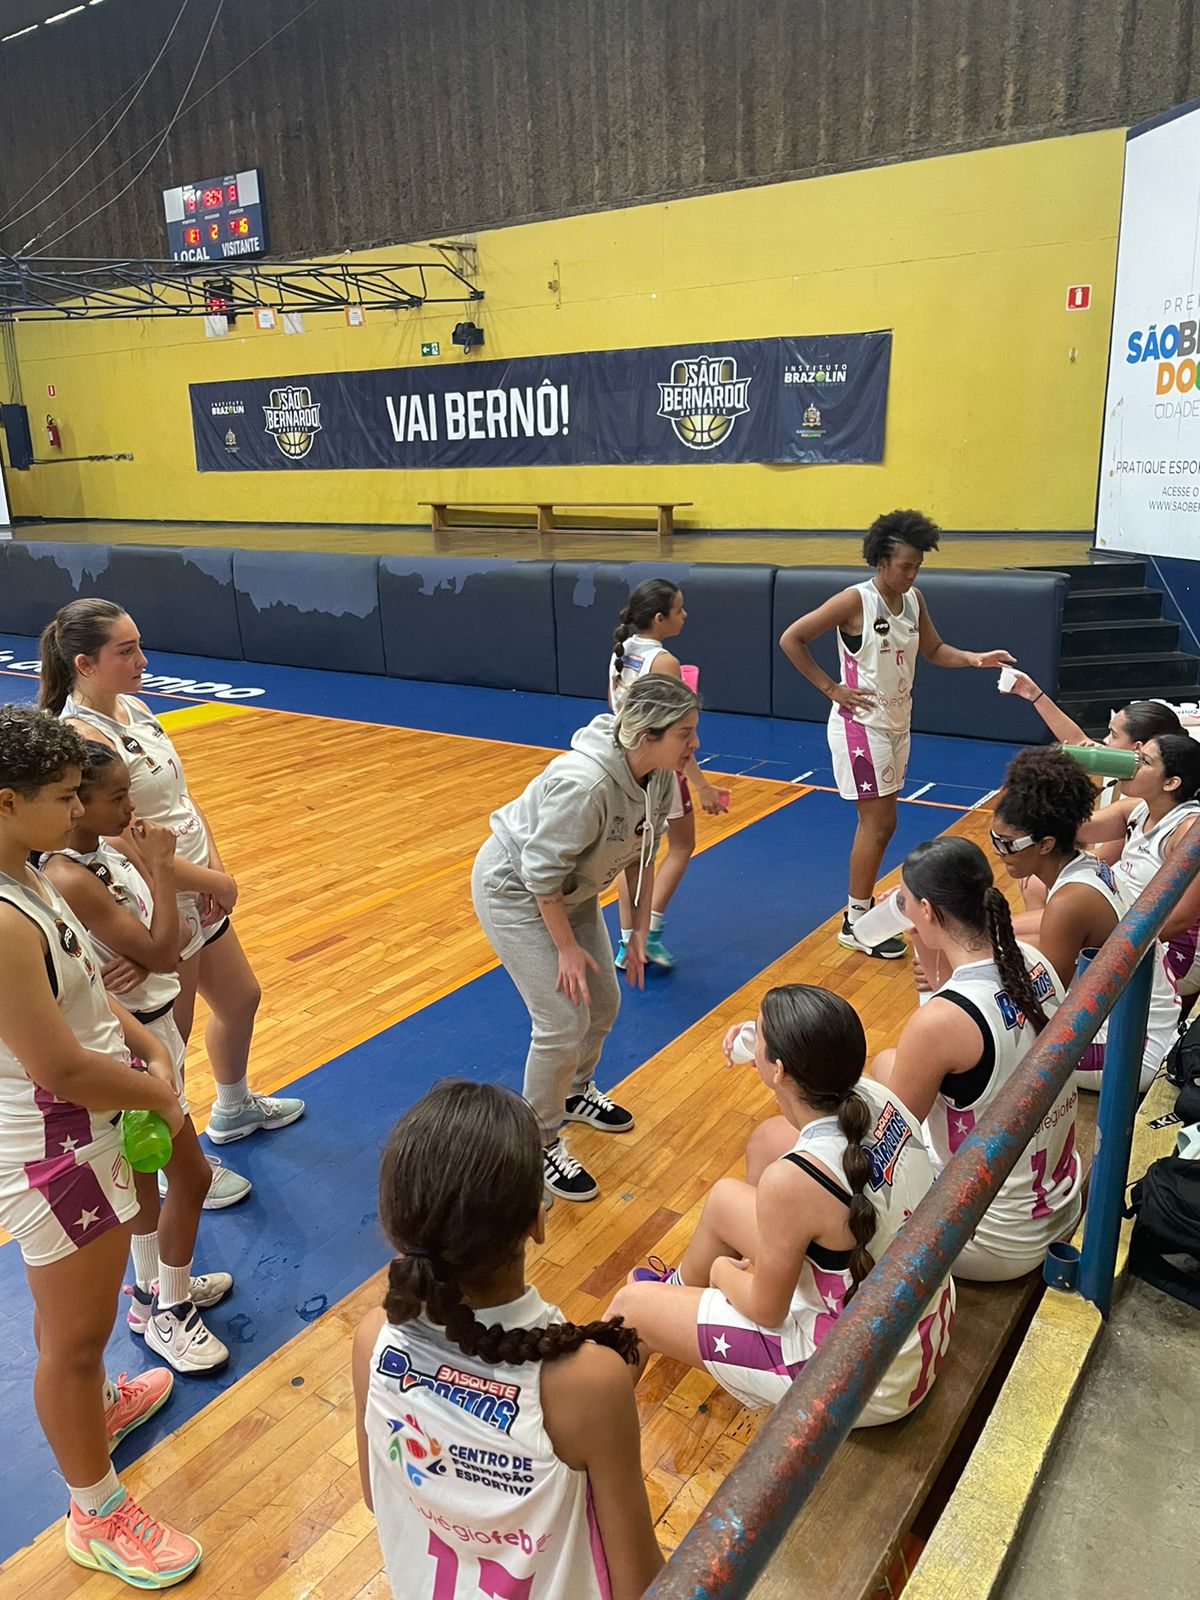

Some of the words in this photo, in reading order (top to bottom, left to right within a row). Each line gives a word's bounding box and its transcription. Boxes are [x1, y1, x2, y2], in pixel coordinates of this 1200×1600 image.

[174, 247, 210, 260] LOCAL
[222, 237, 260, 256] VISITANTE
[1164, 294, 1200, 314] PRE
[1126, 320, 1200, 364] SÃOB
[688, 360, 719, 387] SÃO
[785, 364, 848, 372] INSTITUTO
[1156, 358, 1200, 395] DO
[280, 389, 301, 410] SÃO
[385, 394, 437, 442] VAI
[444, 378, 569, 441] BERNÔ!
[663, 384, 744, 412] BERNARDO
[267, 407, 319, 429] BERNARDO
[1116, 461, 1166, 475] PRATIQUE
[1169, 460, 1200, 475] ESPO
[1162, 486, 1190, 498] ACESSE
[438, 1365, 518, 1400] BASQUETE
[449, 1444, 509, 1468] CENTRO
[512, 1454, 533, 1471] DE
